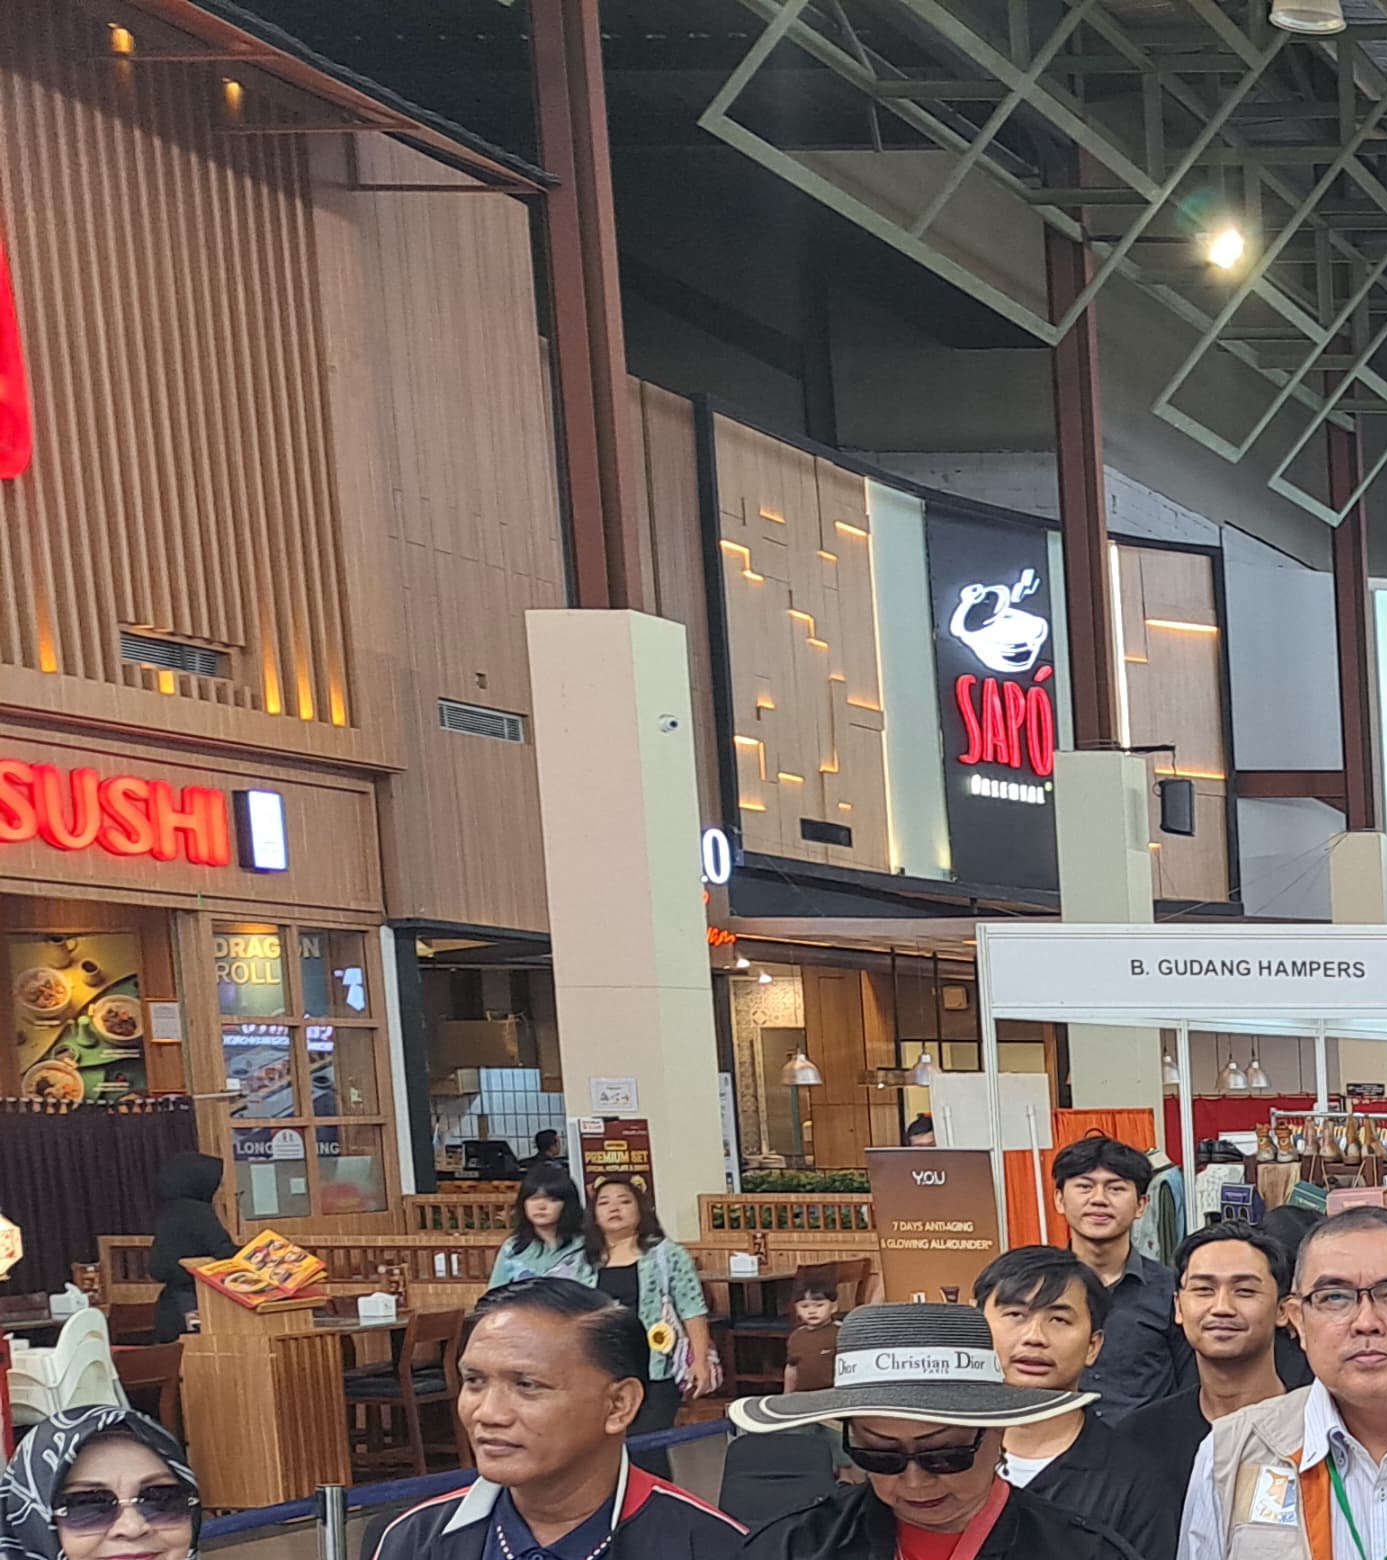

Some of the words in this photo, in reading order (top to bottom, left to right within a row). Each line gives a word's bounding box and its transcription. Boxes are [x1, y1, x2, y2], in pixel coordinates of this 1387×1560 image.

[956, 665, 1054, 776] SAPÓ
[0, 758, 231, 868] SUSHI
[214, 937, 321, 959] DRAGN
[215, 962, 281, 985] ROLL
[1130, 959, 1150, 976] B.
[1158, 959, 1250, 976] GUDANG
[1258, 960, 1366, 979] HAMPERS
[584, 1151, 630, 1164] PREMIUM
[631, 1150, 649, 1163] SET
[892, 1221, 898, 1231] 7
[900, 1221, 923, 1231] DAYS
[887, 1238, 929, 1249] GLOWING
[875, 1352, 950, 1370] Christian
[956, 1351, 985, 1370] Dior
